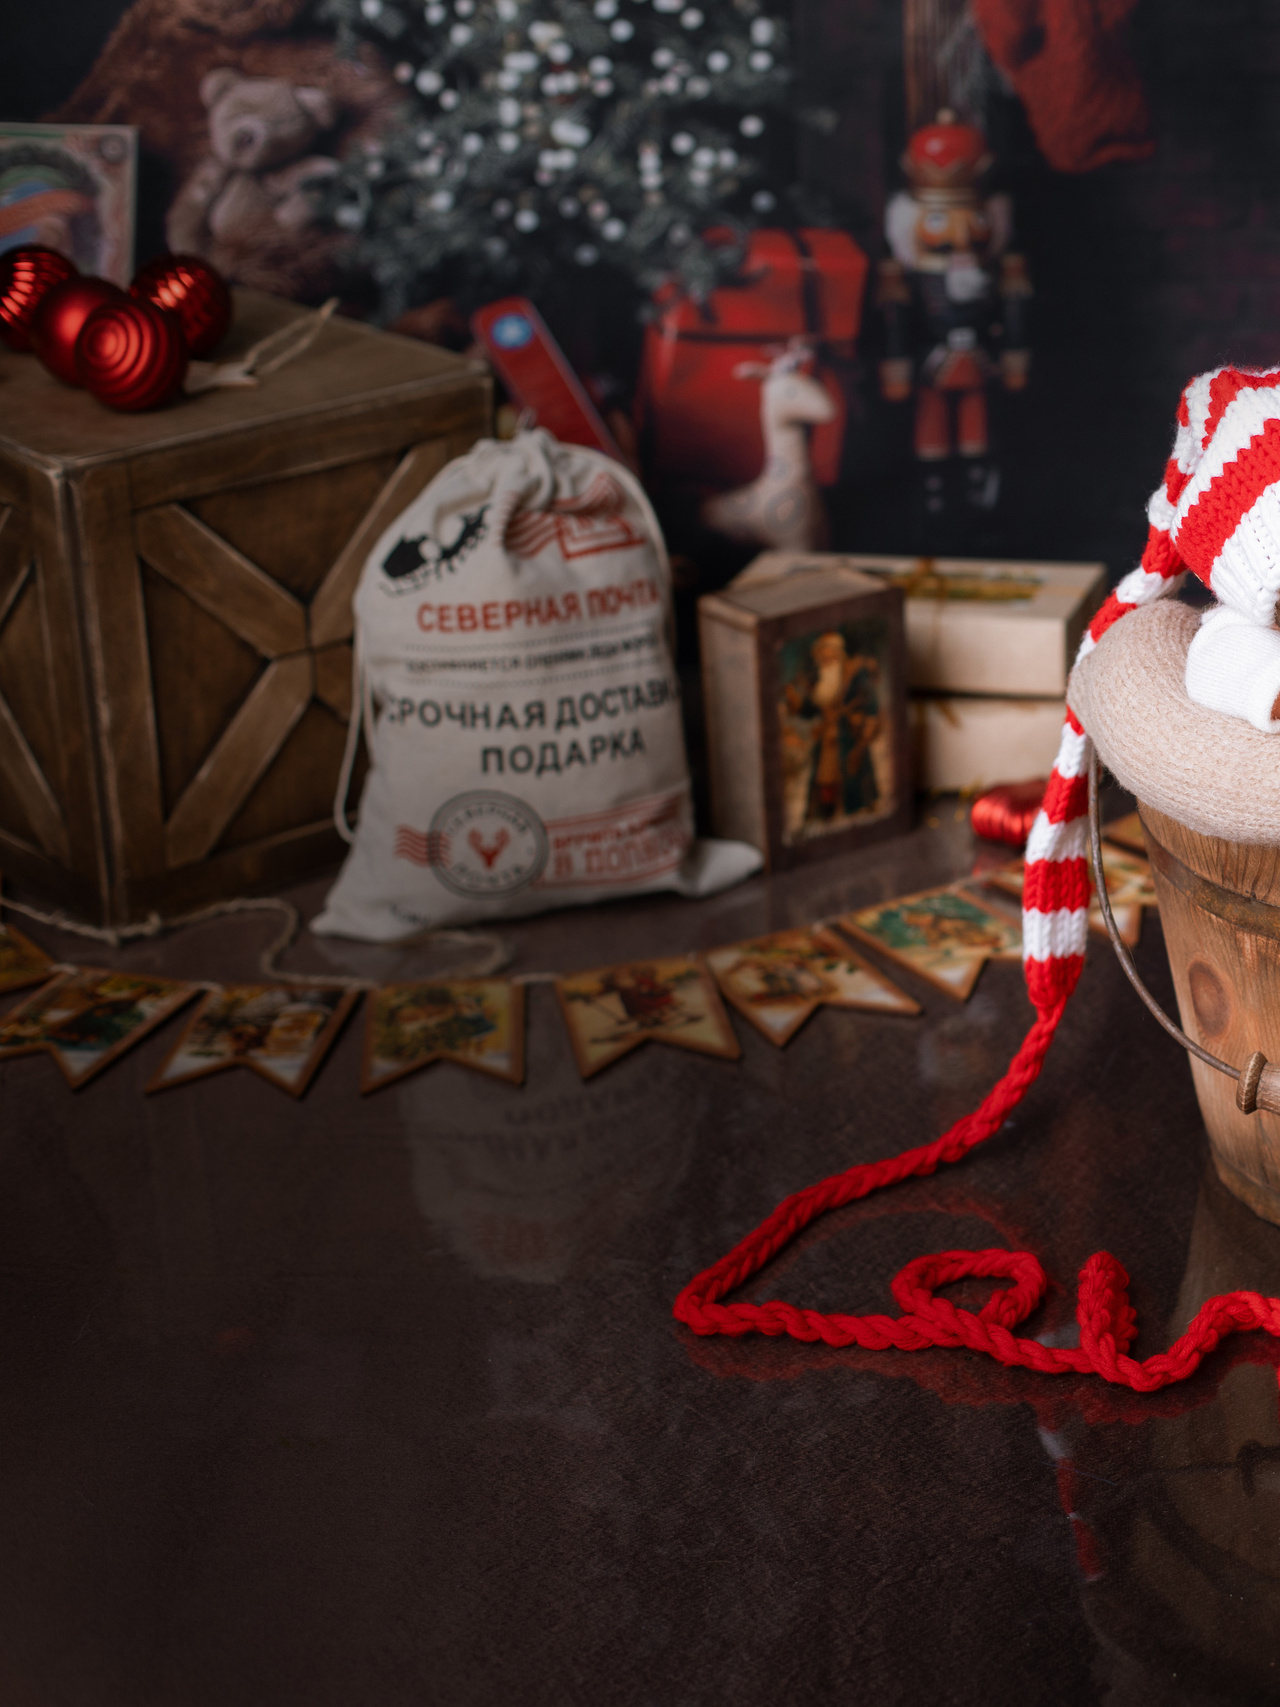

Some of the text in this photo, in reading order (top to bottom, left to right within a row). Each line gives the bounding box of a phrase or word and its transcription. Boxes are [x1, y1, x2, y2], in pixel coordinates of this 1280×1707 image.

[416, 578, 662, 633] СЕВЕРНАЯ ПОЧТА
[480, 727, 647, 777] ПОДАРКА
